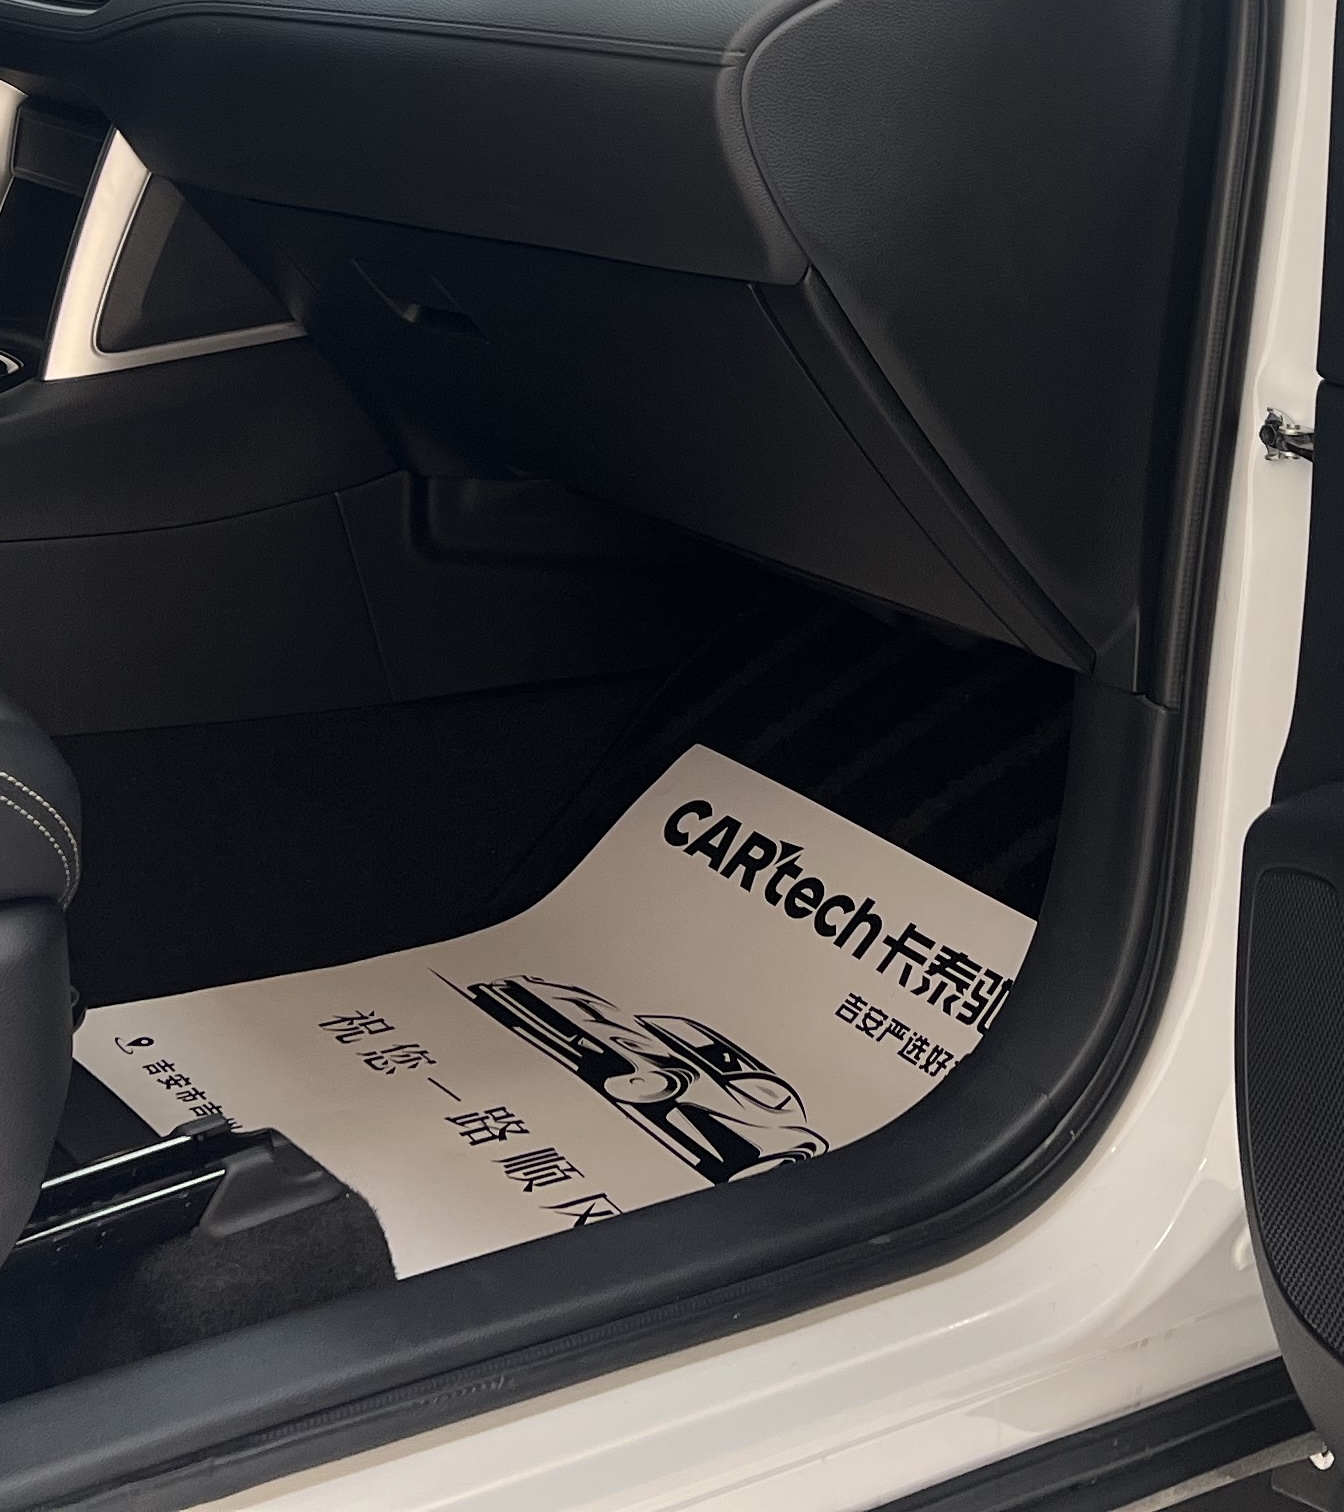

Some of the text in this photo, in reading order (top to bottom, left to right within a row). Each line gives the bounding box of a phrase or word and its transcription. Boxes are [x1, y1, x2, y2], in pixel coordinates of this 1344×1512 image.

[834, 991, 960, 1078] 吉安严选好
